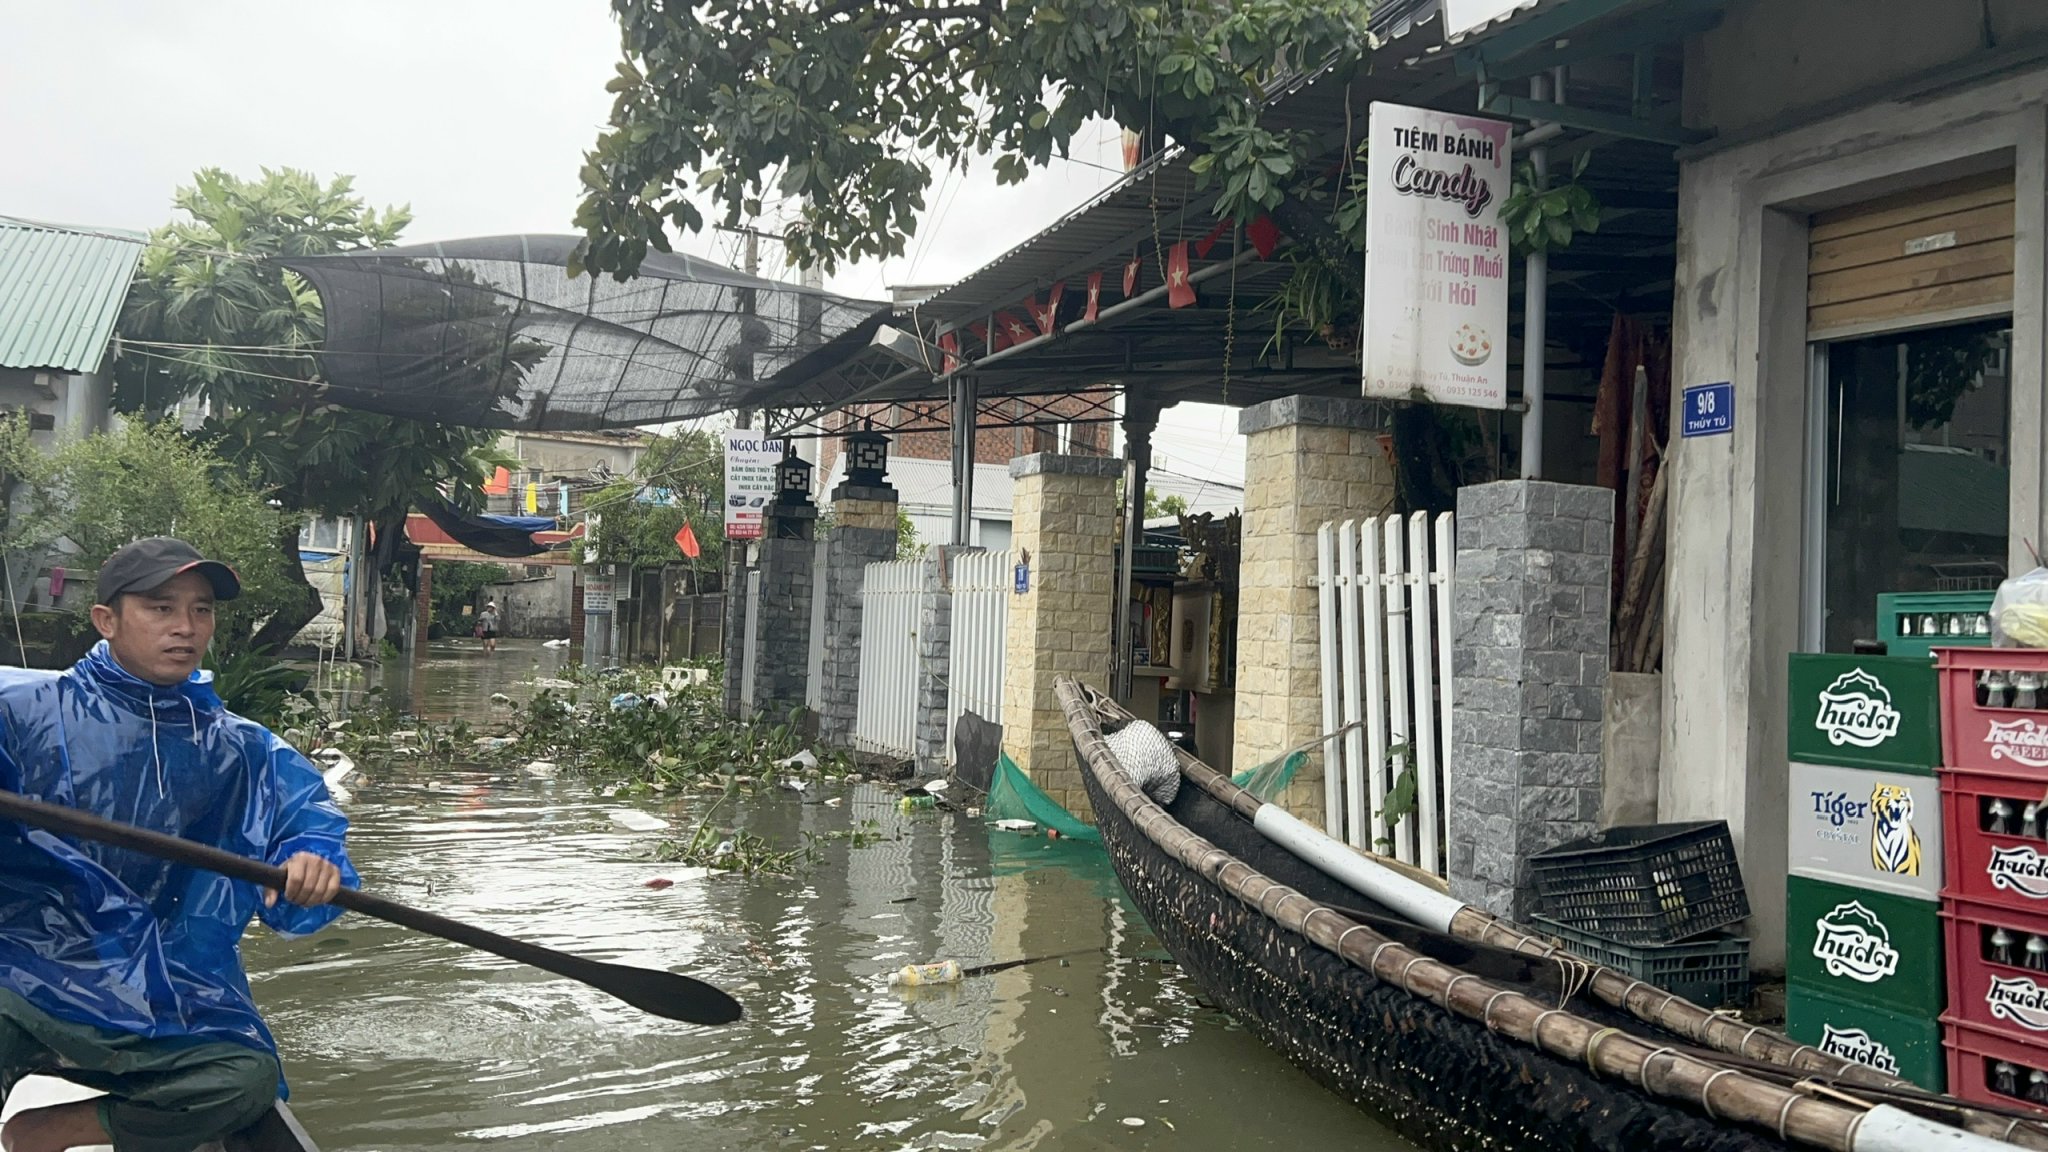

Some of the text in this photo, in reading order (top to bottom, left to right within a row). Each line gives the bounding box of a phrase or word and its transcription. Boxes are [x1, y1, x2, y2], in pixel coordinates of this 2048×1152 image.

[1393, 126, 1494, 160] TIỆM BÁNH
[1391, 154, 1493, 218] Candy
[1427, 218, 1459, 243] Sinh
[1463, 223, 1498, 252] Nhật
[1437, 250, 1470, 278] Trứng
[1473, 253, 1503, 279] Muối
[1448, 281, 1476, 306] Hỏi
[1483, 388, 1498, 398] 546
[1697, 391, 1715, 415] 9/8
[1713, 414, 1726, 426] TÚ
[730, 439, 760, 454] NGỌC
[1817, 693, 1899, 735] huda
[1983, 719, 2048, 747] hud
[1811, 791, 1868, 827] Tiger
[1816, 925, 1896, 970] huda
[1822, 1029, 1897, 1073] huda
